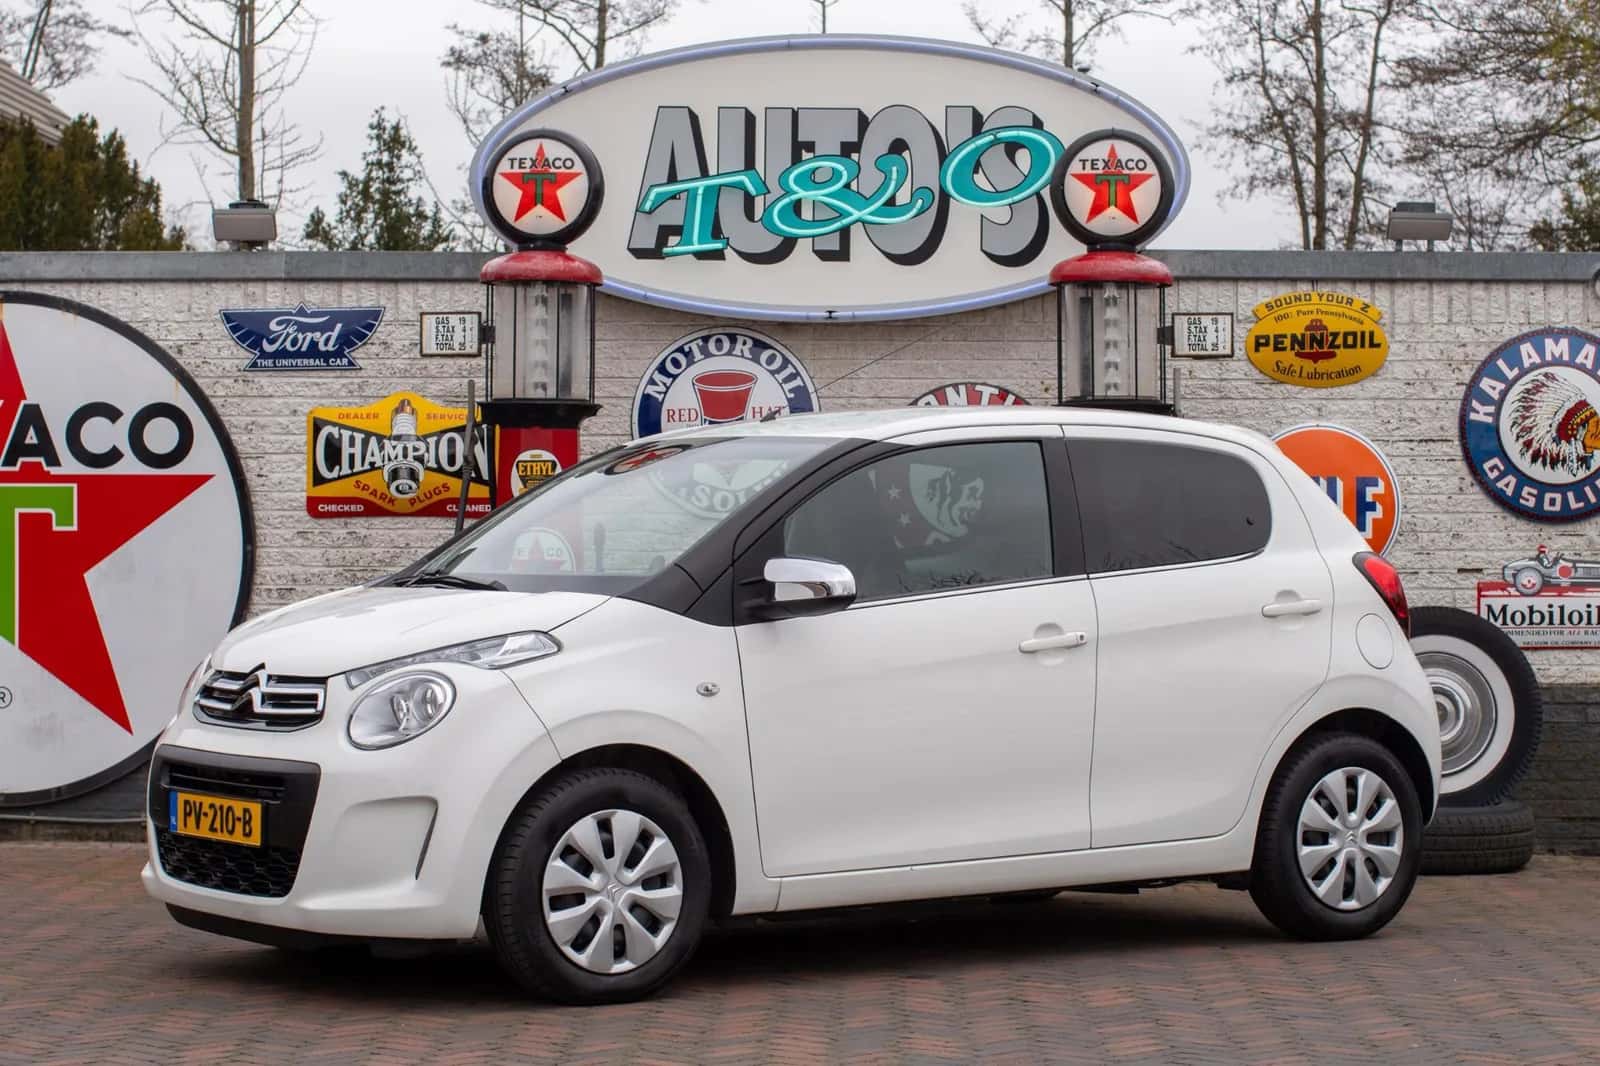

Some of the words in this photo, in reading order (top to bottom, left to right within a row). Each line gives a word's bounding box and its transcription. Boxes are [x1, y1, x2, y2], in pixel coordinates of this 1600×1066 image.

[508, 157, 575, 170] TEXACO
[1079, 158, 1148, 171] TEXACO
[627, 104, 1050, 267] AUTO'S
[1264, 292, 1313, 313] SOUND
[1316, 292, 1355, 307] YOUR
[1359, 302, 1371, 313] Z
[435, 316, 450, 326] GAS
[1187, 316, 1202, 326] GAS
[262, 315, 343, 353] Ford
[1254, 330, 1383, 353] PENNZOIL
[435, 342, 456, 351] TOTAL
[1187, 343, 1209, 352] TOTAL
[256, 358, 274, 367] THE
[276, 358, 327, 367] UNIVERSAL
[329, 358, 349, 367] CAR
[645, 334, 754, 402] MOTOR
[759, 349, 804, 399] OIL
[1272, 359, 1297, 377] Safe
[1299, 364, 1362, 381] Lubrication
[1469, 338, 1600, 423] KALAMA
[338, 412, 380, 420] DEALER
[425, 412, 470, 421] SERVIC
[666, 407, 699, 423] RED
[315, 424, 489, 481] CHAMPION
[518, 461, 554, 476] ETHYL
[353, 479, 396, 507] SPARK
[408, 482, 452, 507] PLUGS
[1482, 457, 1600, 512] GASOLI
[318, 504, 364, 512] CHECKED
[446, 504, 492, 512] CLANED
[183, 798, 253, 838] PV-210-B
